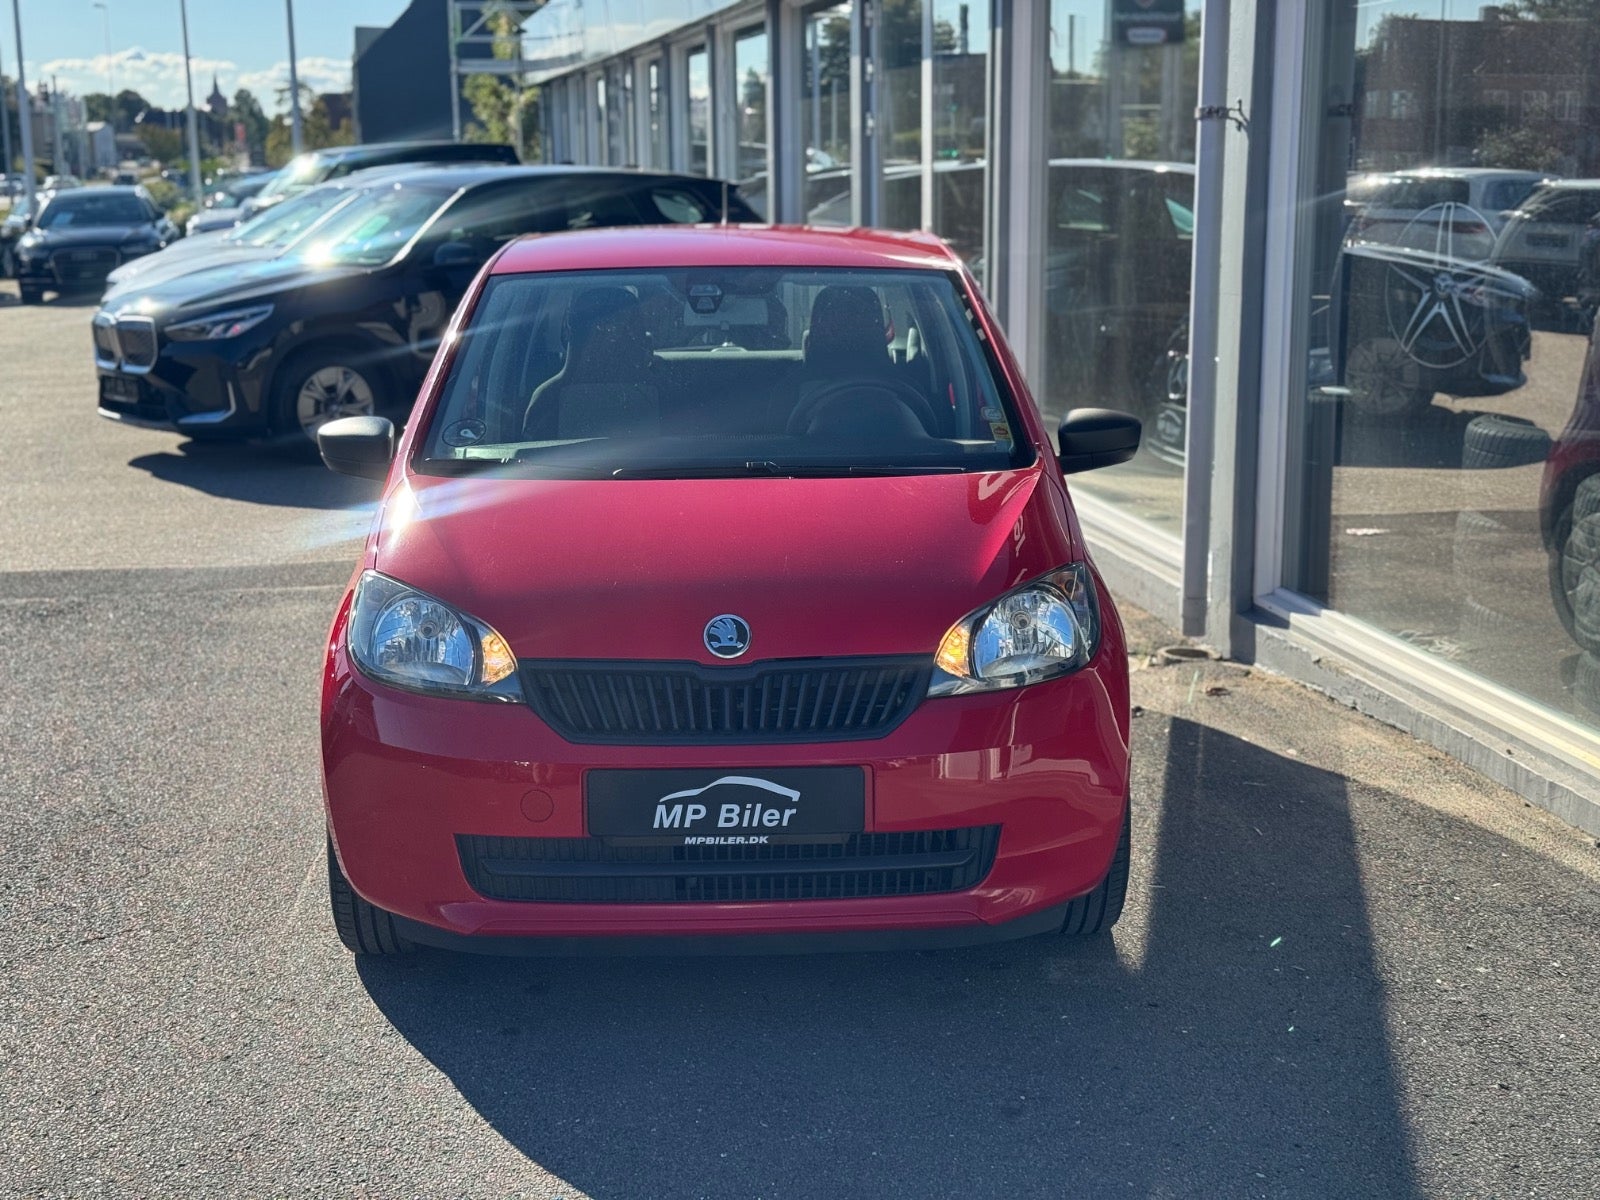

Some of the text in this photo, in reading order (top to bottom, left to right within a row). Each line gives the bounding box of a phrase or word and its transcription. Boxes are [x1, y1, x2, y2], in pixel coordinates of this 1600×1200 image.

[653, 803, 797, 829] MP Biler
[684, 836, 769, 845] MPBILER.DK
